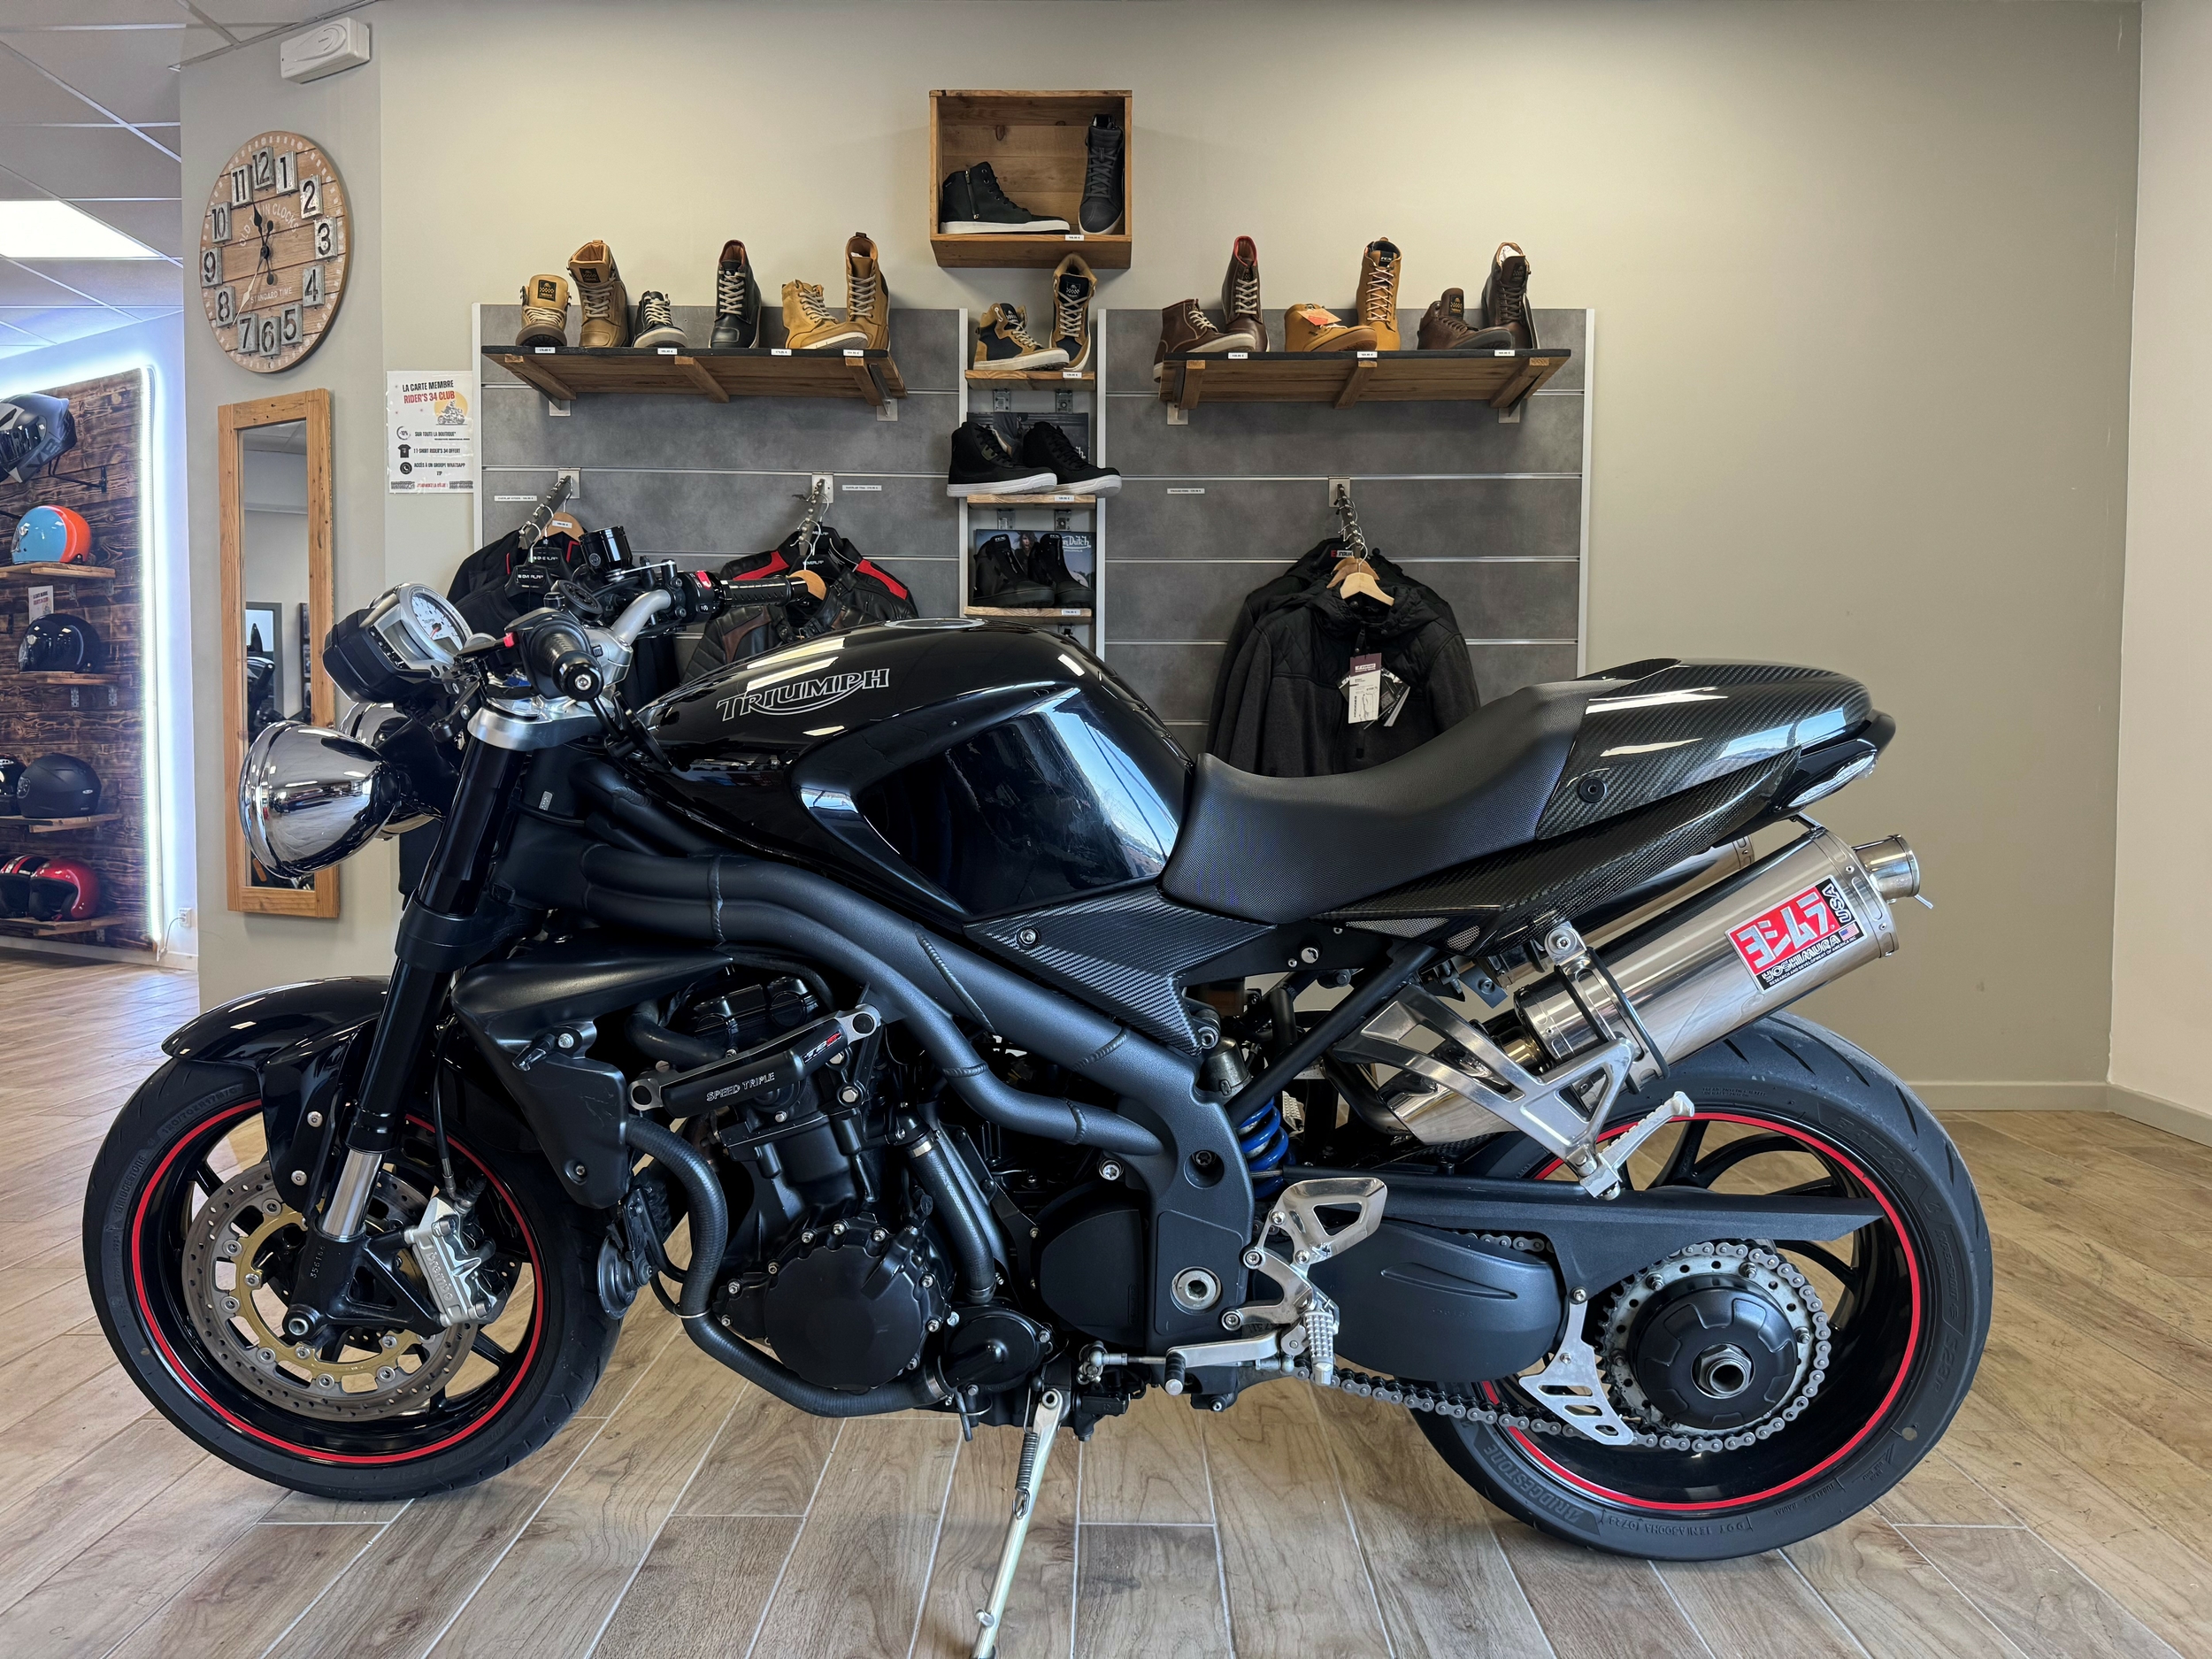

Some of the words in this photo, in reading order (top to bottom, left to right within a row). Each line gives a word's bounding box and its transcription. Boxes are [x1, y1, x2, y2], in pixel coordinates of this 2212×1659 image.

[252, 150, 270, 185] 12
[280, 156, 288, 189] 1
[232, 168, 248, 203] 11
[303, 180, 316, 214] 2
[211, 207, 225, 240] 10
[239, 225, 250, 247] OLD
[272, 203, 299, 233] CLOCKS
[316, 221, 331, 256] 3
[204, 250, 216, 283] 9
[250, 290, 278, 303] STANDARD
[279, 287, 292, 297] TIME
[304, 268, 319, 302] 4
[217, 290, 229, 322] 8
[239, 317, 252, 349] 7
[261, 320, 275, 353] 6
[283, 309, 297, 341] 5
[403, 393, 428, 403] RIDER'S
[428, 392, 437, 402] 34
[438, 390, 455, 401] CLUB
[410, 382, 427, 392] CARTE
[428, 380, 454, 389] MEMBRE
[1069, 535, 1090, 548] Dutch
[715, 668, 890, 722] TRIUMPH
[1822, 883, 1852, 924] USA
[1736, 892, 1829, 970] ヨシムラ
[1762, 934, 1841, 983] YOSHIMURA
[1769, 972, 1790, 987] RESEARCH
[1790, 966, 1800, 976] AND
[1798, 954, 1826, 972] DEVELOPMENT
[1831, 940, 1850, 954] AMERICA
[706, 1084, 741, 1102] SPEED
[741, 1071, 776, 1090] TRIPLE
[113, 1155, 147, 1213] BRIDGESTONE
[426, 1250, 454, 1302] brembo
[1483, 1443, 1585, 1523] BRIDGESTONE
